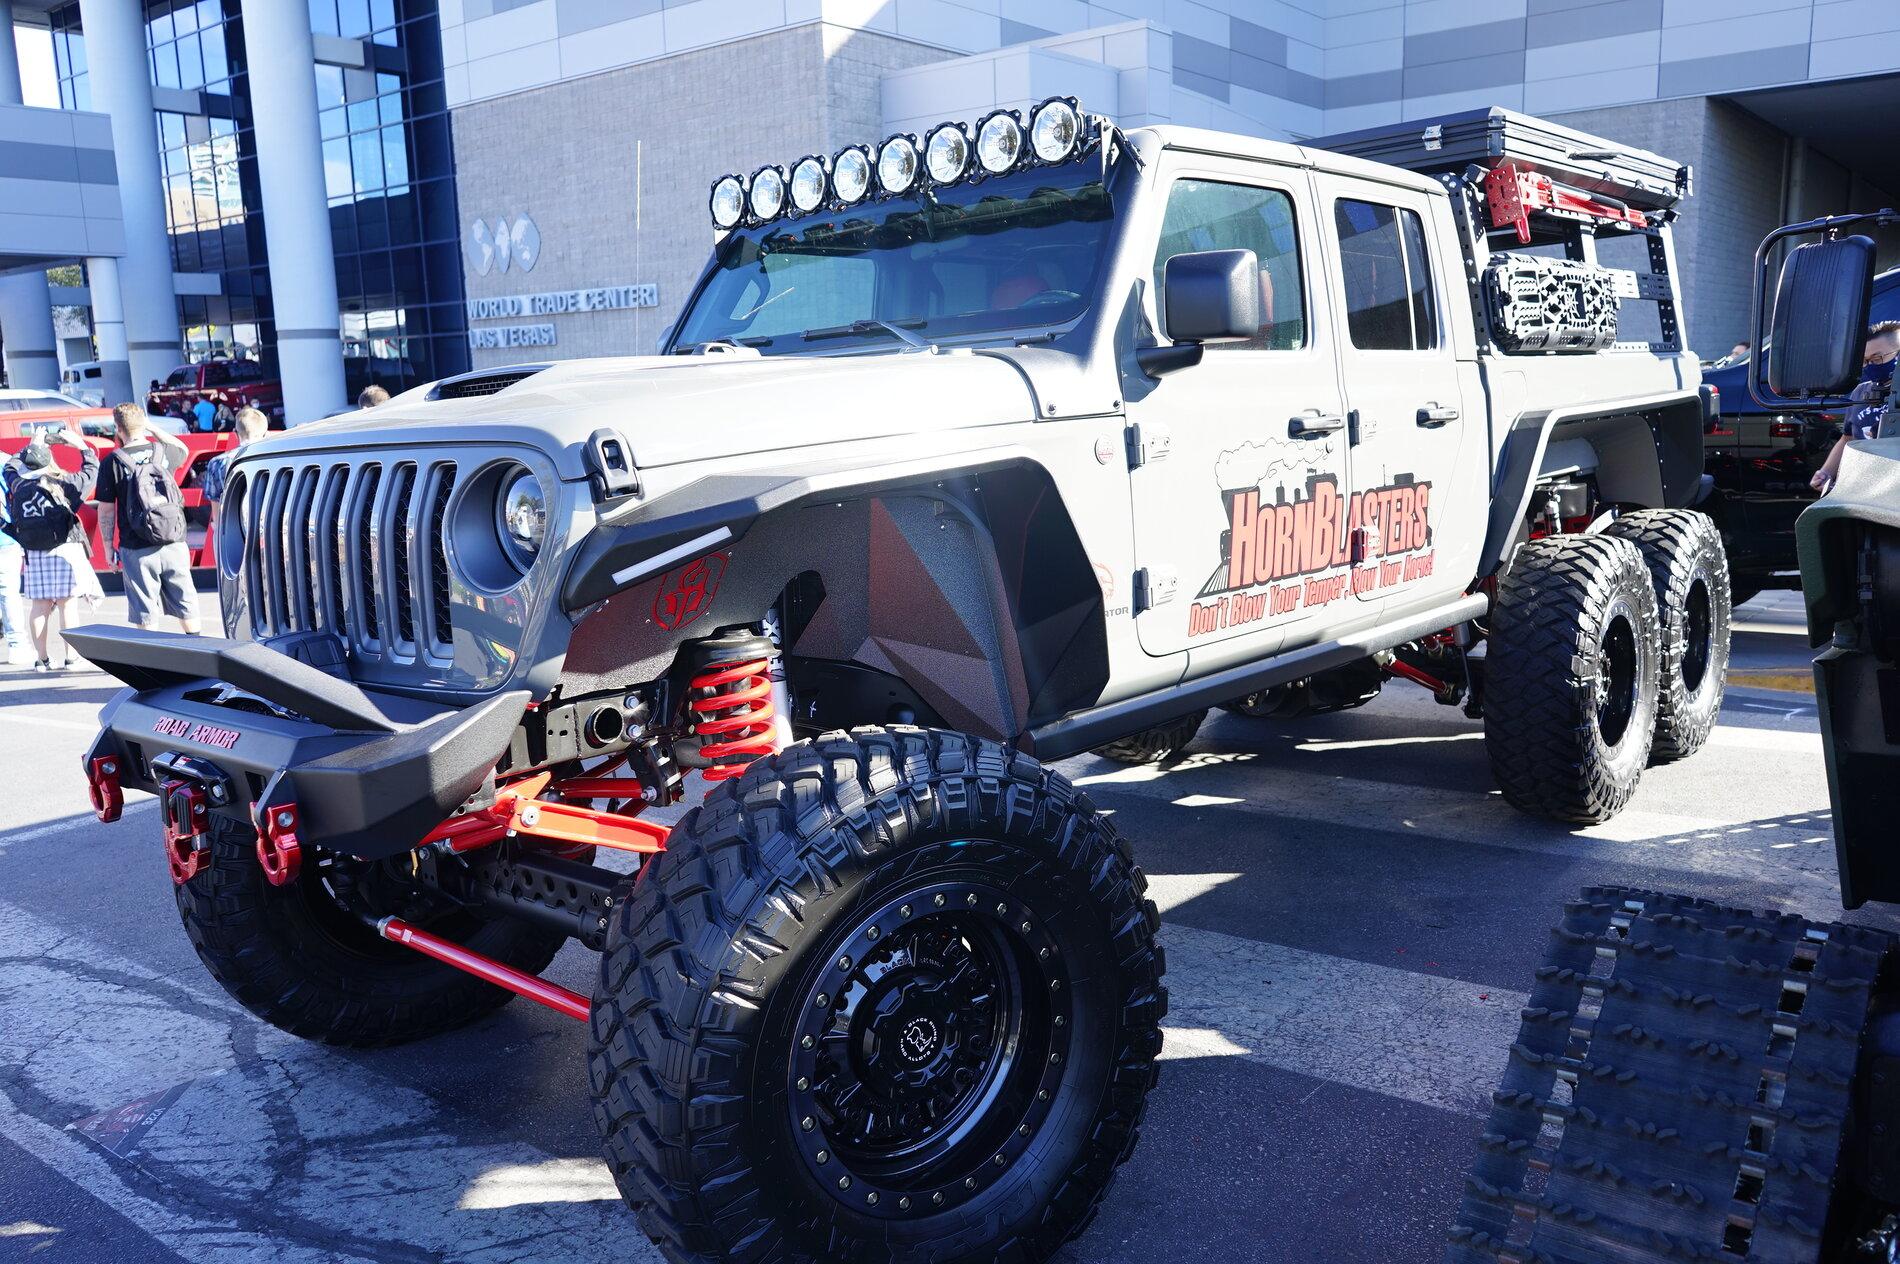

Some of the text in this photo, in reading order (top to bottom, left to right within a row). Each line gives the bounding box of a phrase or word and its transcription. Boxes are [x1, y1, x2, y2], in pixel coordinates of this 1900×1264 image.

[468, 285, 656, 319] WORLD TRADE CENTER
[469, 324, 556, 348] LAS VEGAS
[1188, 596, 1229, 637] Don't
[1229, 591, 1268, 627] Blow
[1269, 584, 1301, 617] Your
[1349, 565, 1378, 596] Blow
[1379, 559, 1402, 589] Your
[153, 716, 242, 749] ROAD ARMOR
